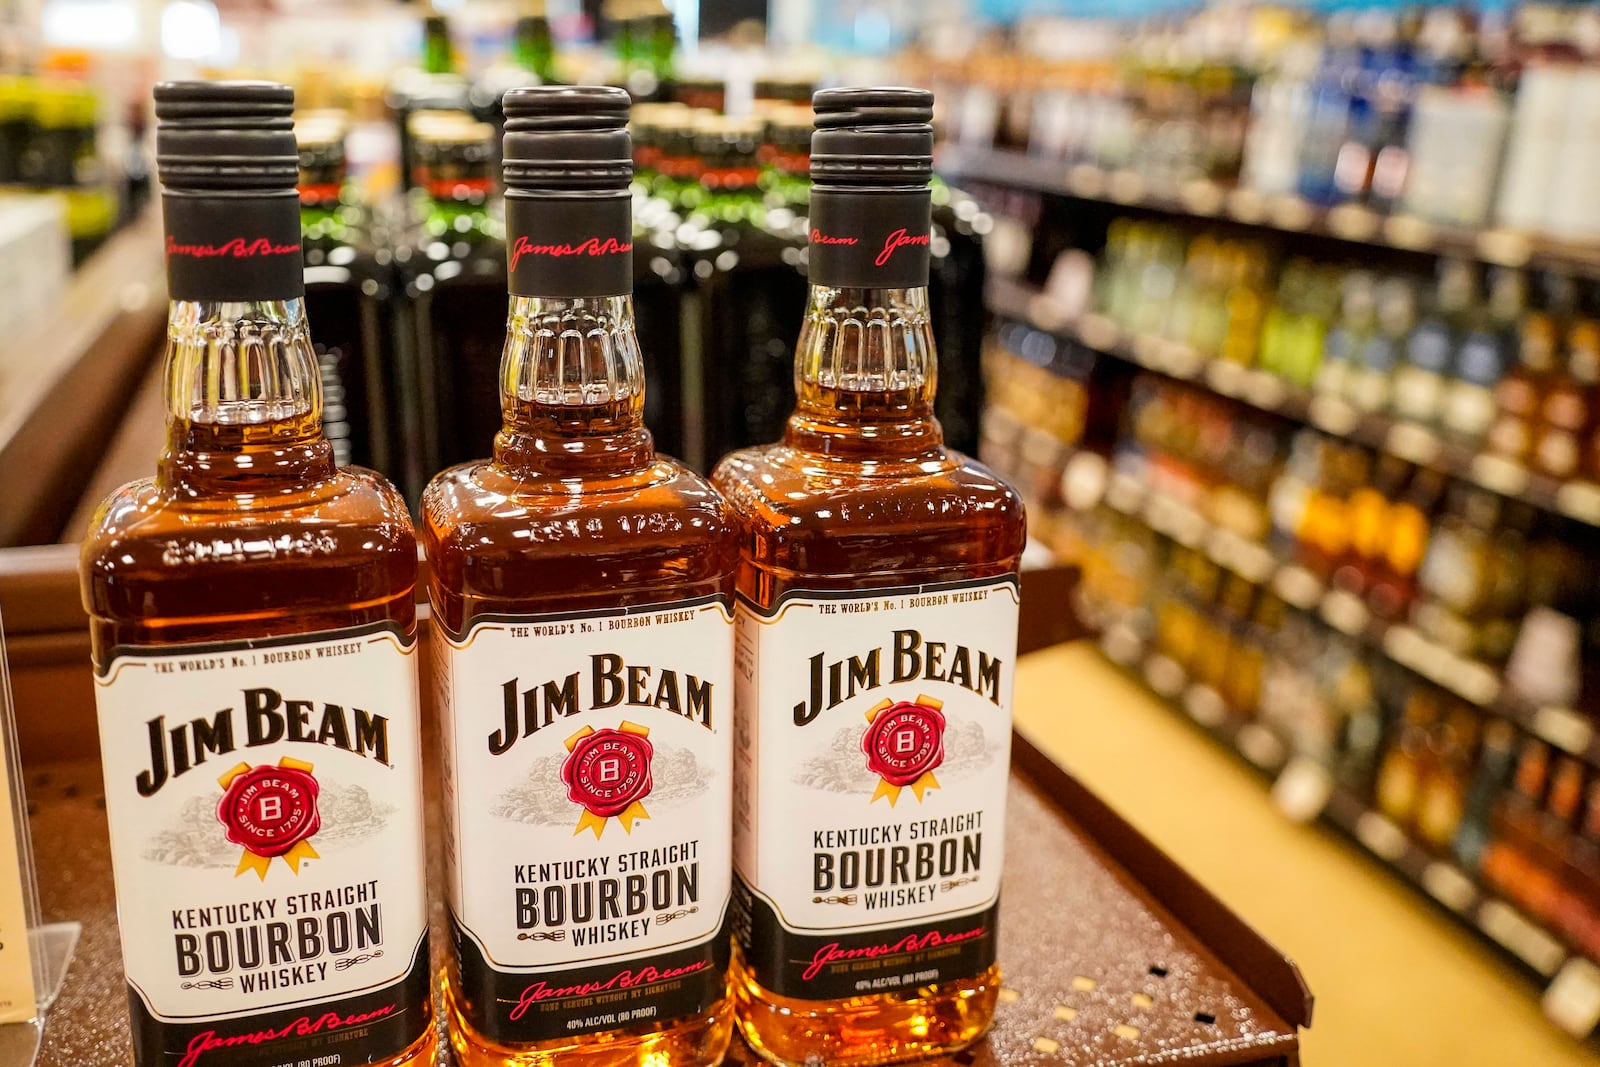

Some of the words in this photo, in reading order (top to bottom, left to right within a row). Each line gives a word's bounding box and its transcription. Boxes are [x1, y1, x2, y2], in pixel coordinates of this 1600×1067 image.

[510, 236, 575, 272] James
[818, 604, 837, 614] THE
[841, 601, 879, 613] WORLD'S
[883, 600, 897, 610] No.
[909, 595, 948, 608] BOURBON
[952, 590, 988, 604] WHISKEY
[510, 627, 529, 638] THE
[534, 623, 575, 637] WORLD'S
[580, 622, 595, 633] No.
[609, 616, 651, 630] BOURBON
[655, 610, 695, 625] WHISKEY
[154, 662, 174, 673] THE
[179, 657, 225, 672] WORLD'S
[263, 649, 311, 665] BOURBON
[316, 642, 362, 658] WHISKEY
[793, 647, 882, 727] JIM
[889, 629, 1002, 706] BEAM
[488, 671, 581, 756] JIM
[588, 652, 714, 731] BEAM
[881, 719, 897, 737] JIM
[901, 714, 930, 733] BEAM
[136, 707, 237, 797] JIM
[241, 687, 389, 767] BEAM
[583, 748, 599, 766] JIM
[603, 742, 636, 762] BEAM
[879, 747, 907, 768] SINCE
[911, 742, 931, 765] 1795
[896, 730, 915, 753] B
[581, 776, 612, 798] SINCE
[616, 771, 637, 794] 1795
[600, 758, 620, 782] B
[240, 785, 258, 804] JIM
[262, 779, 299, 799] BEAM
[239, 814, 275, 837] SINCE
[280, 808, 302, 833] 1795
[259, 796, 282, 821] B
[814, 824, 902, 849] KENTUCKY
[910, 810, 984, 840] STRAIGHT
[514, 856, 610, 884] KENTUCKY
[618, 840, 699, 873] STRAIGHT
[813, 832, 982, 893] BOURBON
[172, 899, 277, 930] KENTUCKY
[287, 880, 378, 915] STRAIGHT
[515, 861, 700, 930] BOURBON
[864, 884, 937, 910] WHISKEY
[174, 902, 384, 978] BOURBON
[572, 917, 651, 947] WHISKEY
[802, 943, 888, 981] James
[239, 962, 327, 994] WHISKEY
[509, 981, 600, 1021] James
[632, 960, 706, 986] Beam
[567, 1019, 583, 1030] 40%
[585, 1013, 616, 1028] ALC/VOL
[618, 1011, 630, 1023] (80
[631, 1006, 657, 1020] PROOF)
[178, 1030, 276, 1067] James
[314, 1004, 395, 1030] Beam
[312, 1053, 341, 1067] PROOF)
